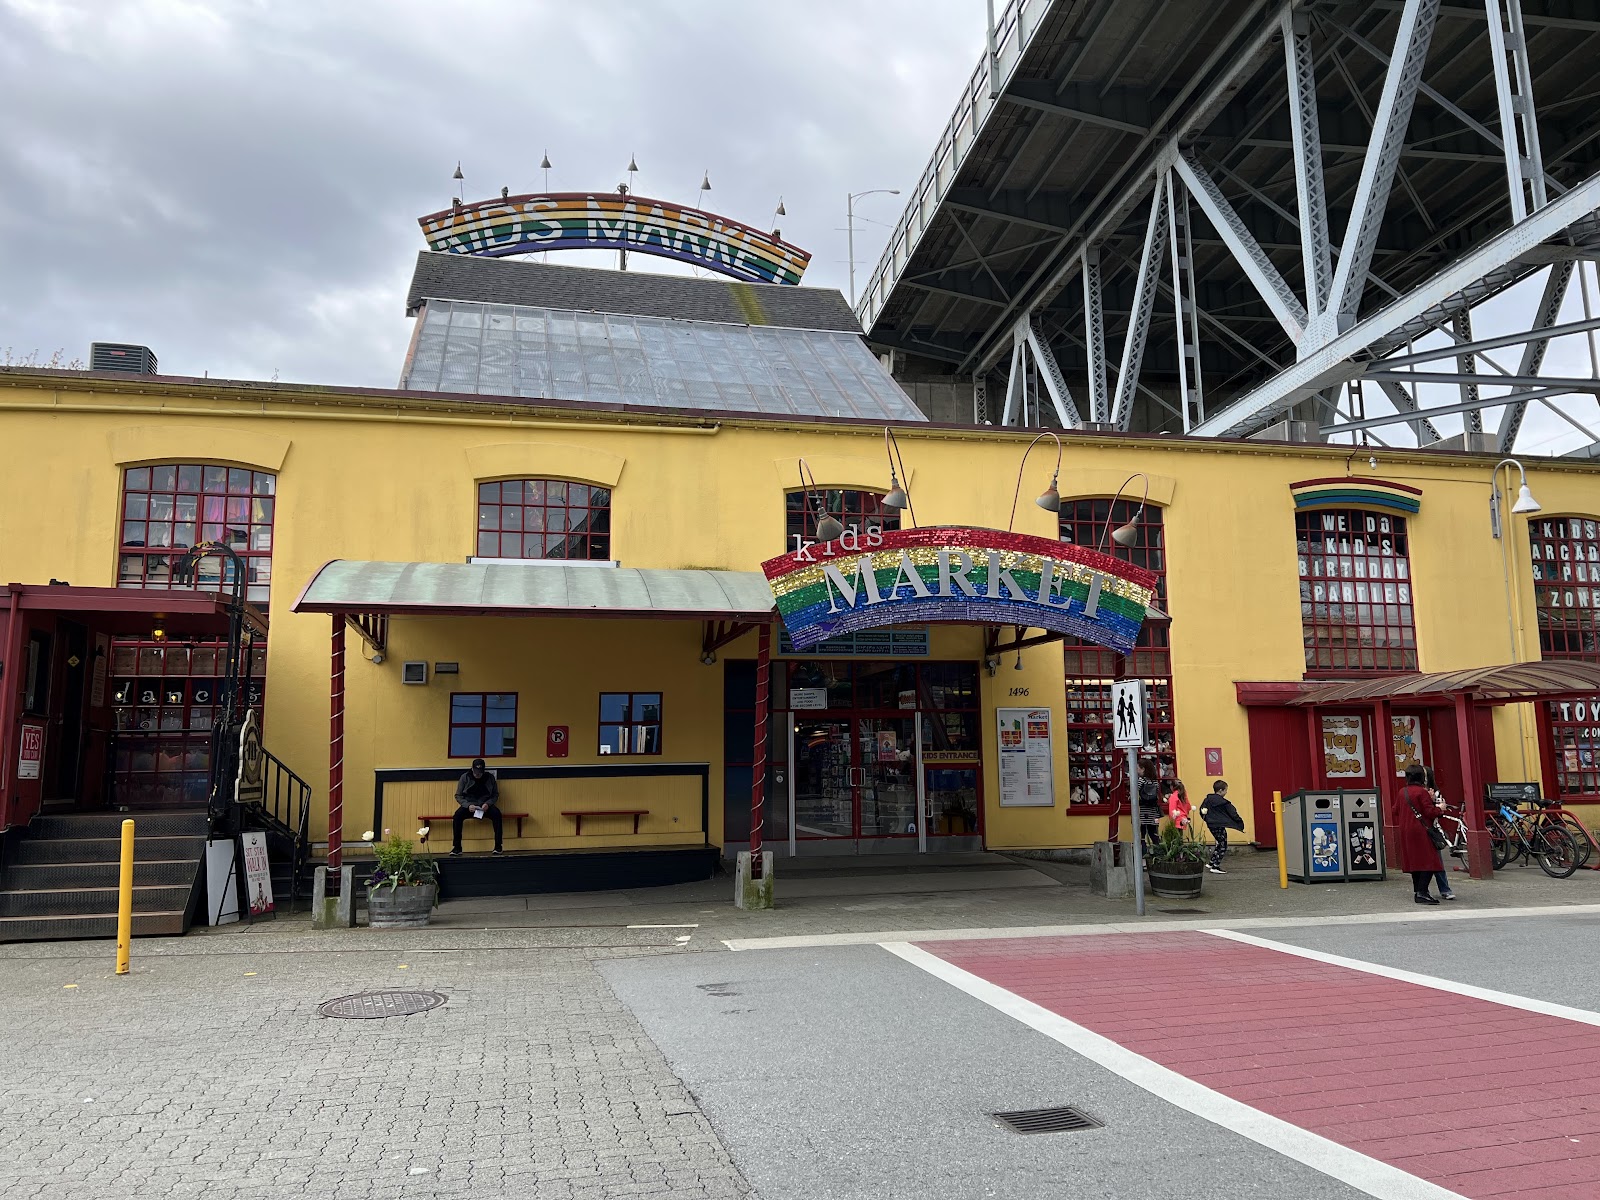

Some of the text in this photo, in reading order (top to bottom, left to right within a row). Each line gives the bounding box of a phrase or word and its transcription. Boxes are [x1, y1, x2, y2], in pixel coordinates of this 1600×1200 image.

[427, 195, 805, 285] KIDS MARKET
[1322, 514, 1391, 534] WE DO
[1543, 522, 1595, 540] KIDS
[793, 525, 883, 562] kids
[1326, 535, 1392, 556] KID'S
[1298, 560, 1406, 579] BIRTHDAY
[1533, 564, 1543, 581] &
[820, 550, 1117, 619] MARKET
[1314, 585, 1408, 604] PARTIES
[1551, 591, 1600, 608] ZONE
[114, 682, 236, 704] danc
[1008, 687, 1030, 697] 1496
[25, 732, 40, 750] YES
[1323, 731, 1357, 754] Toy
